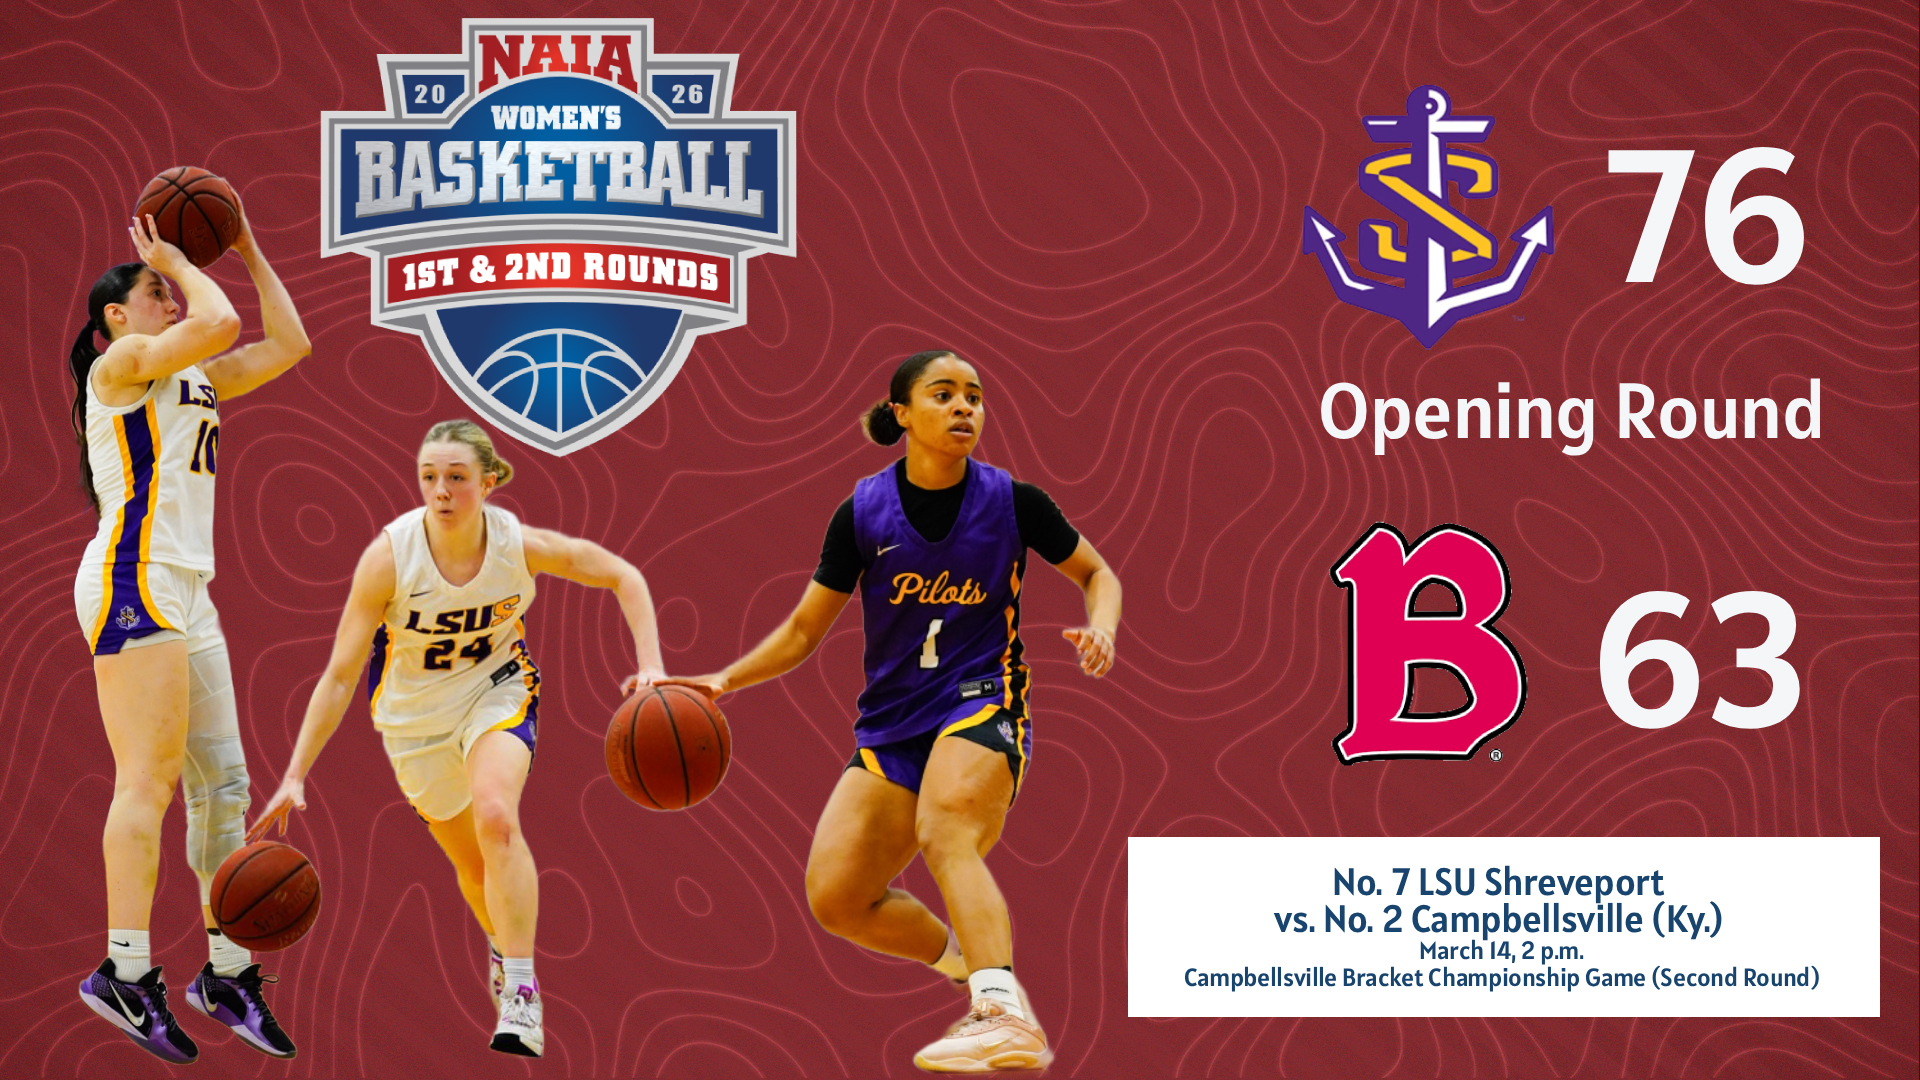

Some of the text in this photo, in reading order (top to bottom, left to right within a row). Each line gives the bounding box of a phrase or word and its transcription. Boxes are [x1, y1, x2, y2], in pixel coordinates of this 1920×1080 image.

[177, 379, 219, 416] LS
[889, 570, 987, 605] Pilots
[423, 632, 494, 671] 24
[919, 618, 944, 669] 1
